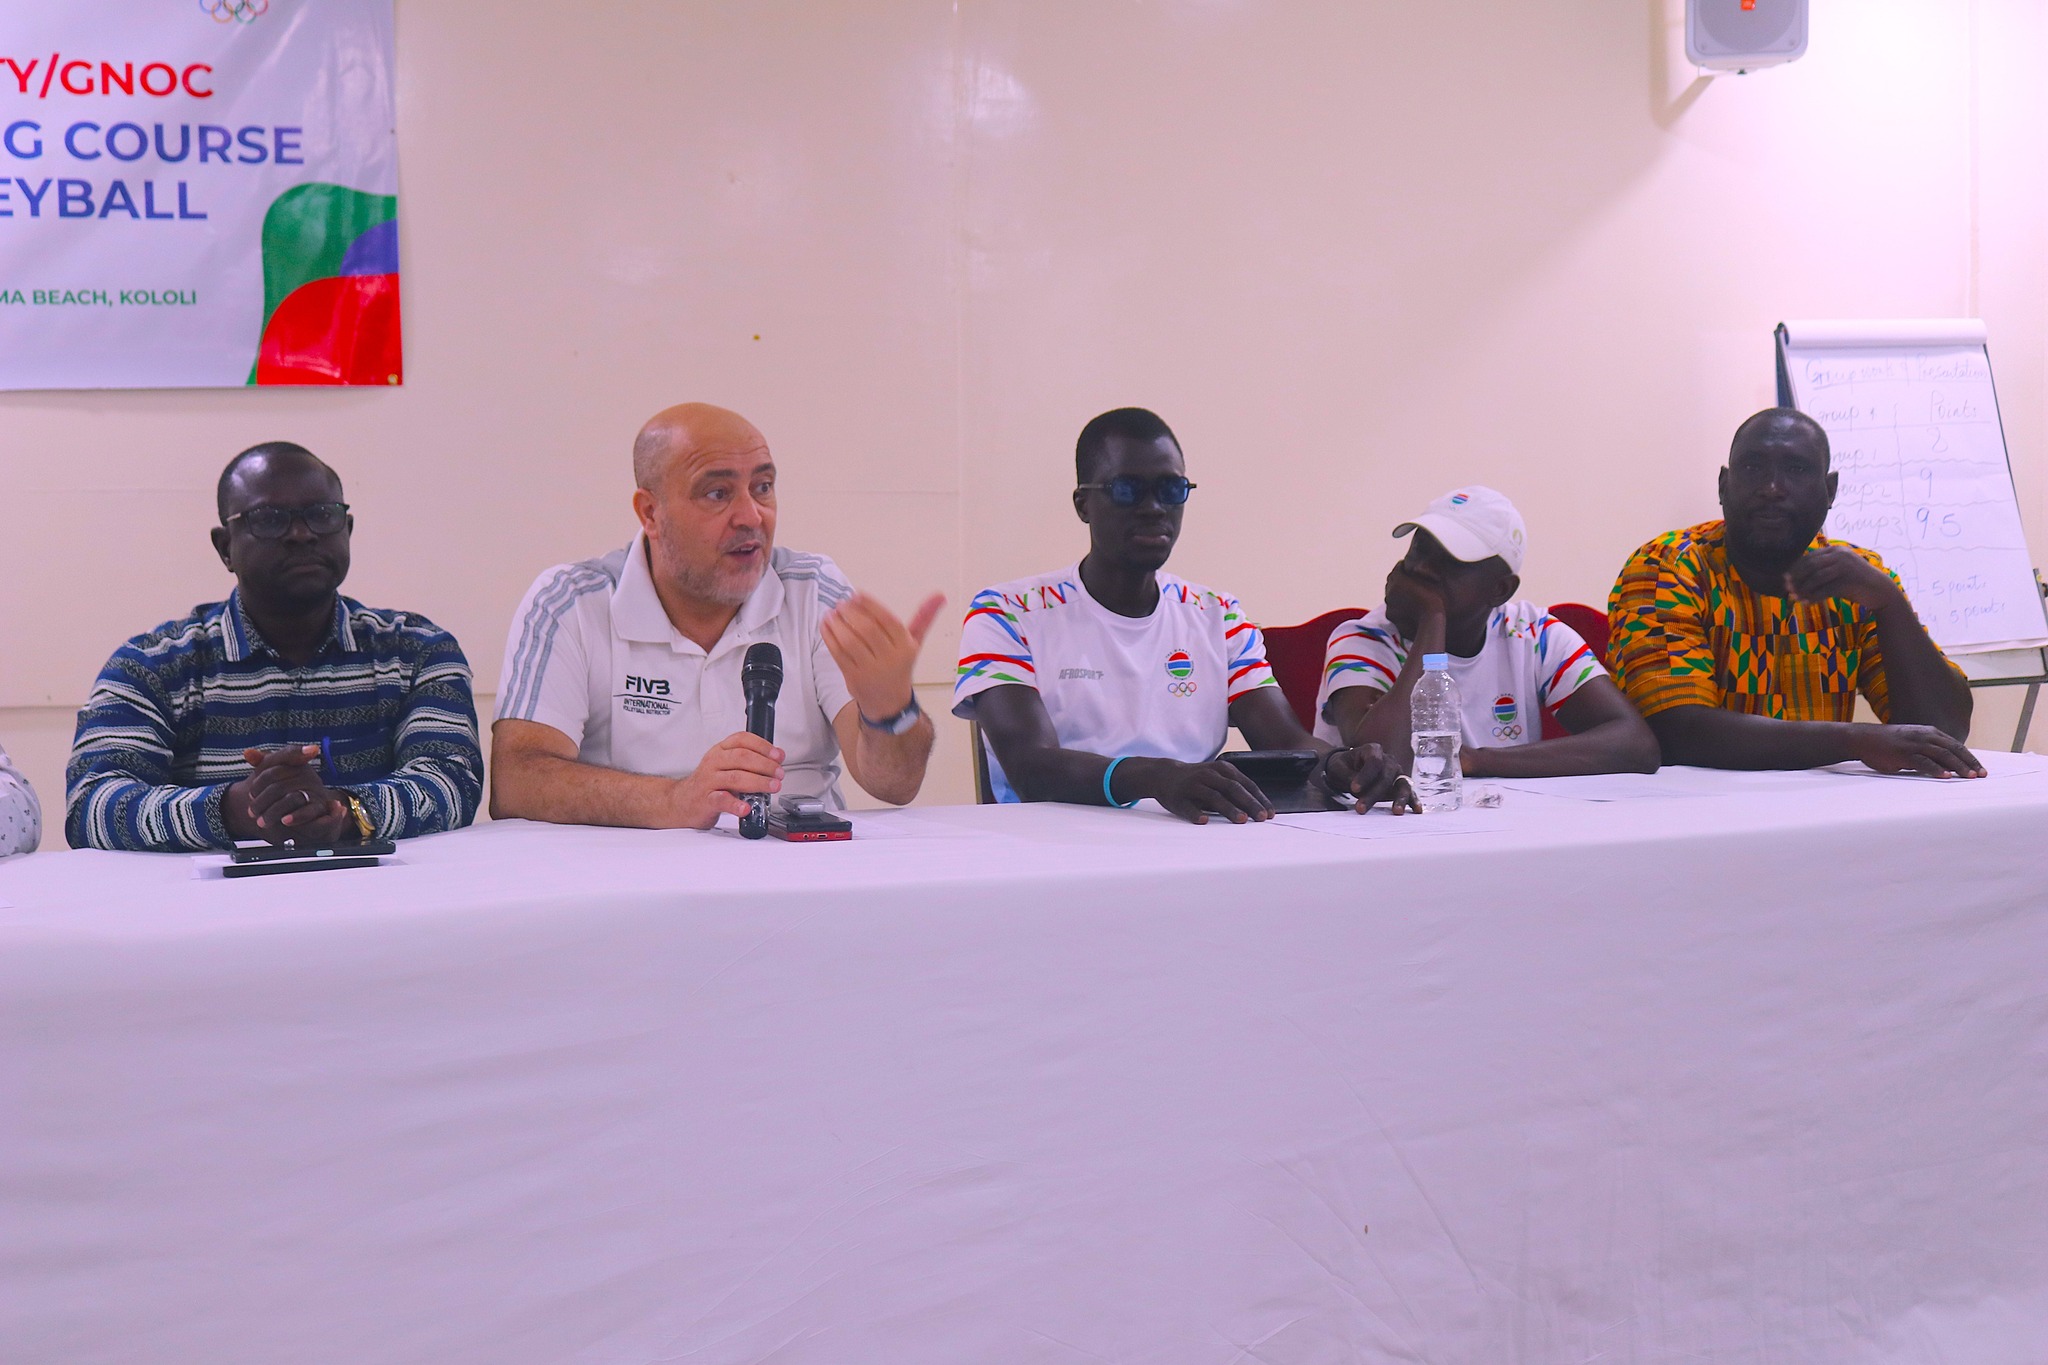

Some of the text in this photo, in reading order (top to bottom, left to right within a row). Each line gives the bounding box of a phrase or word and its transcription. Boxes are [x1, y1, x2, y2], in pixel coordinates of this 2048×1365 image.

[0, 53, 214, 98] Y/GNOC
[64, 121, 304, 165] COURSE
[32, 289, 113, 308] BEACH,
[120, 289, 197, 305] KOLOLI
[1809, 395, 1860, 432] Group
[1832, 448, 1864, 474] roup
[1837, 483, 1873, 512] roup
[626, 675, 671, 695] FIVB
[624, 698, 670, 710] INTERNATIONAL
